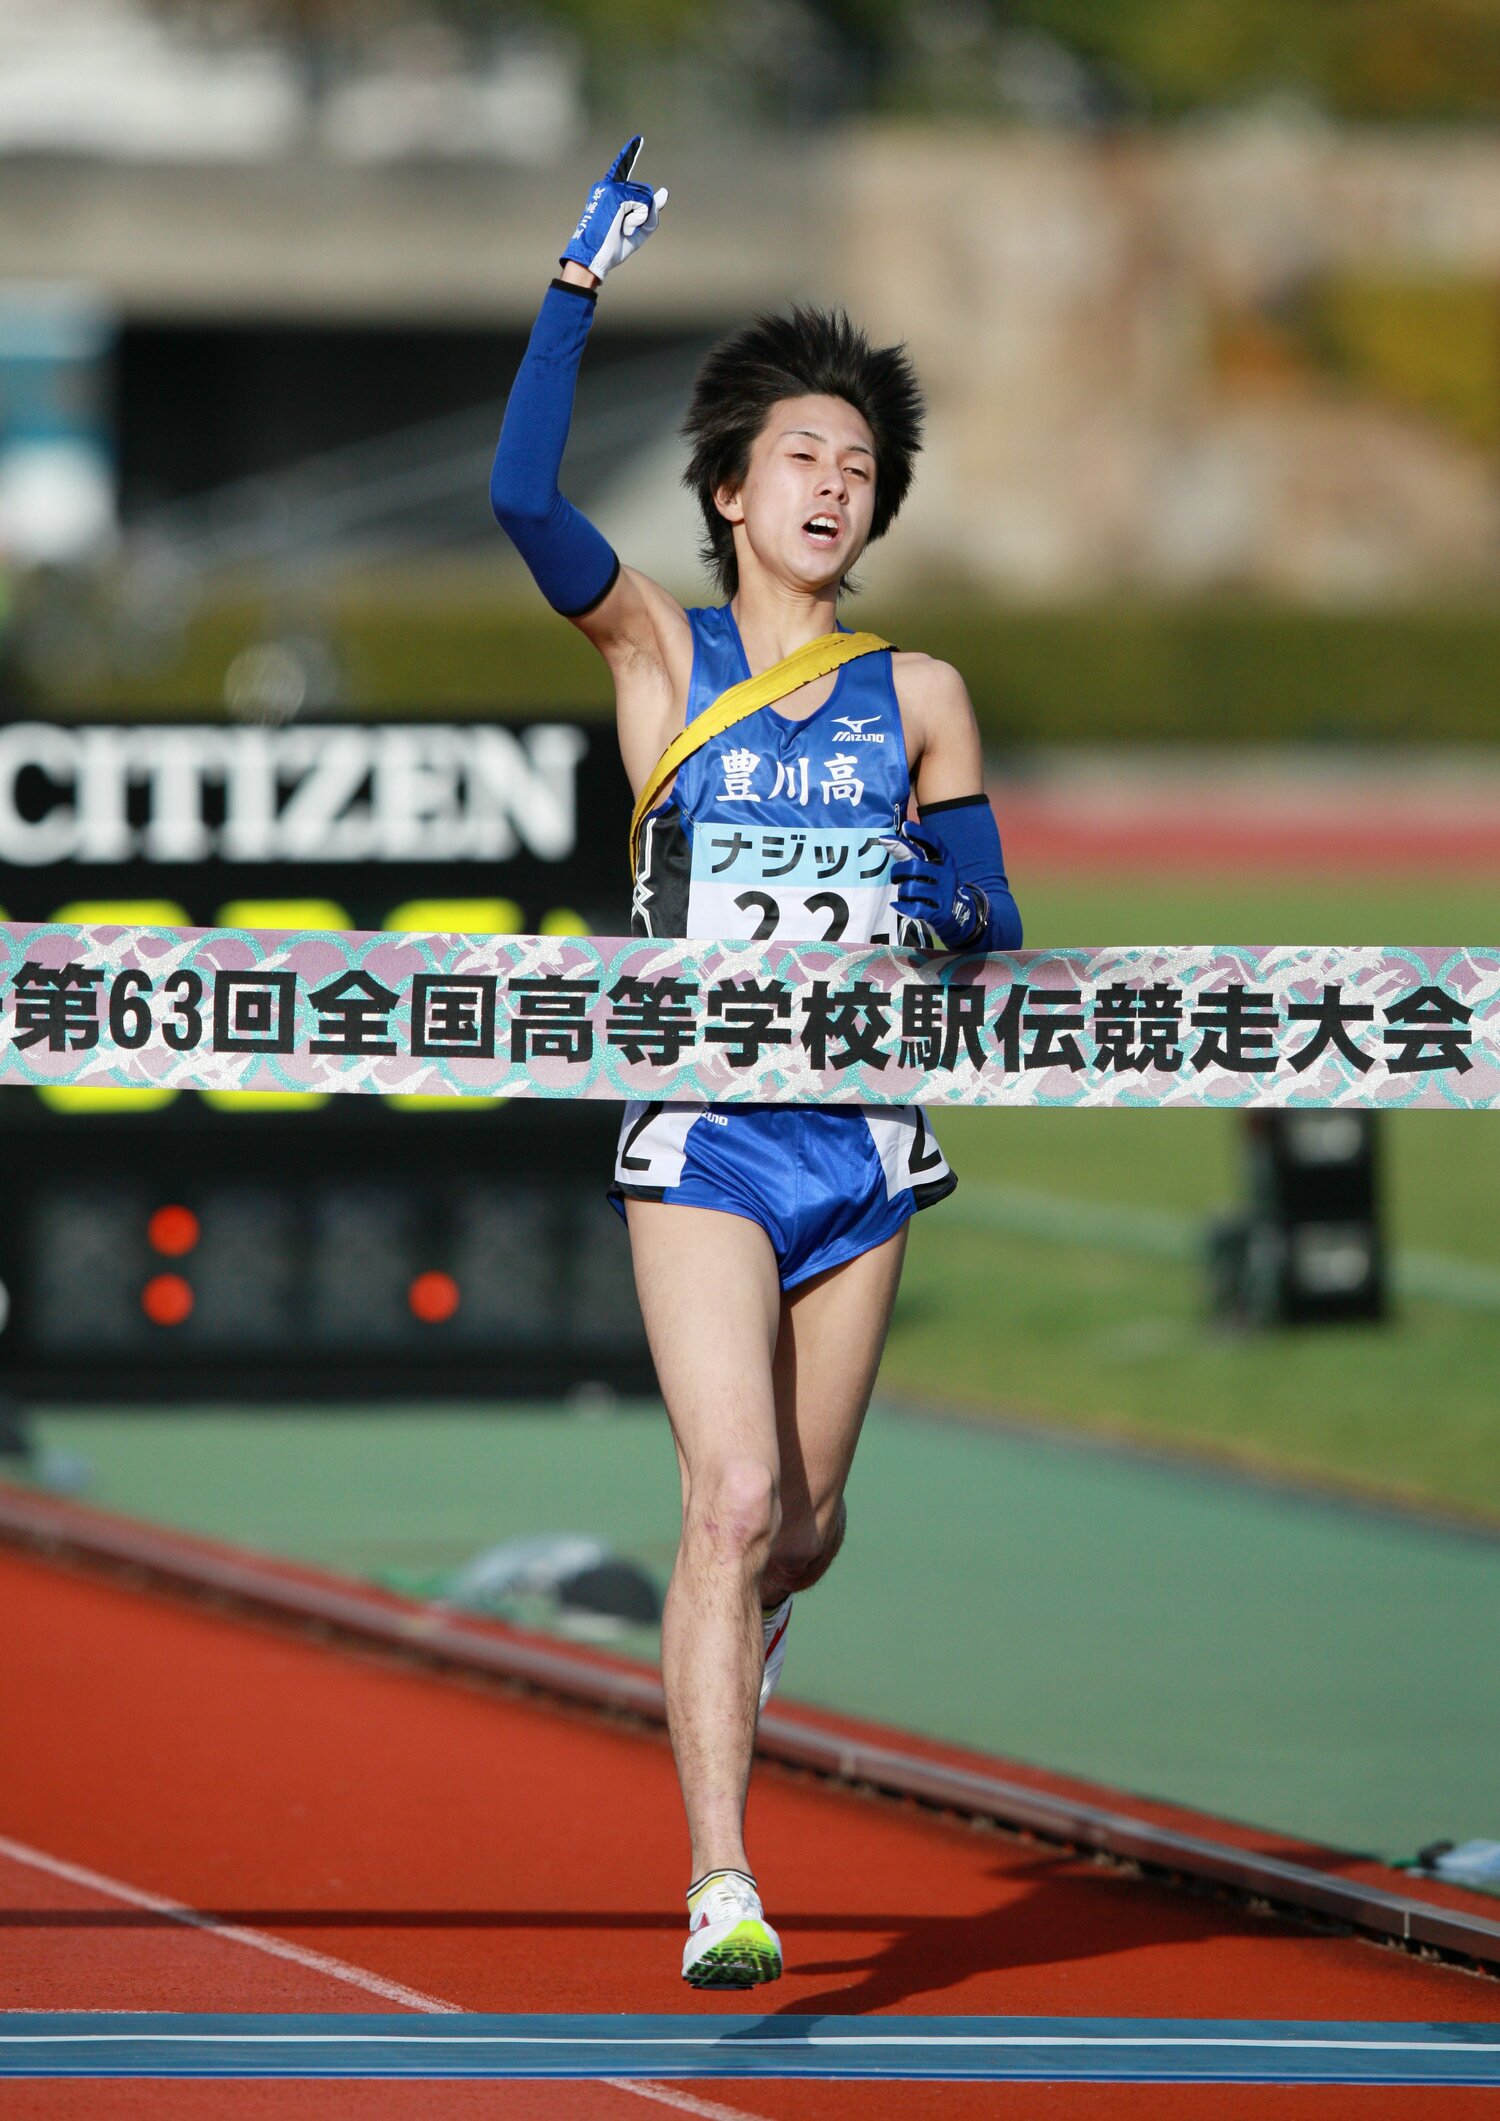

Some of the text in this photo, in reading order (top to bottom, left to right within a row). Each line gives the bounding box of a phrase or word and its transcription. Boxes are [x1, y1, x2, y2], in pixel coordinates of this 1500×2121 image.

[831, 731, 885, 744] MIZUNO
[0, 722, 585, 863] CITIZEN
[715, 747, 865, 807] 豊川高
[711, 832, 890, 879] ナジック
[733, 890, 890, 943] 22
[9, 960, 1475, 1076] 第63回全国高等学校駅伝競走大会
